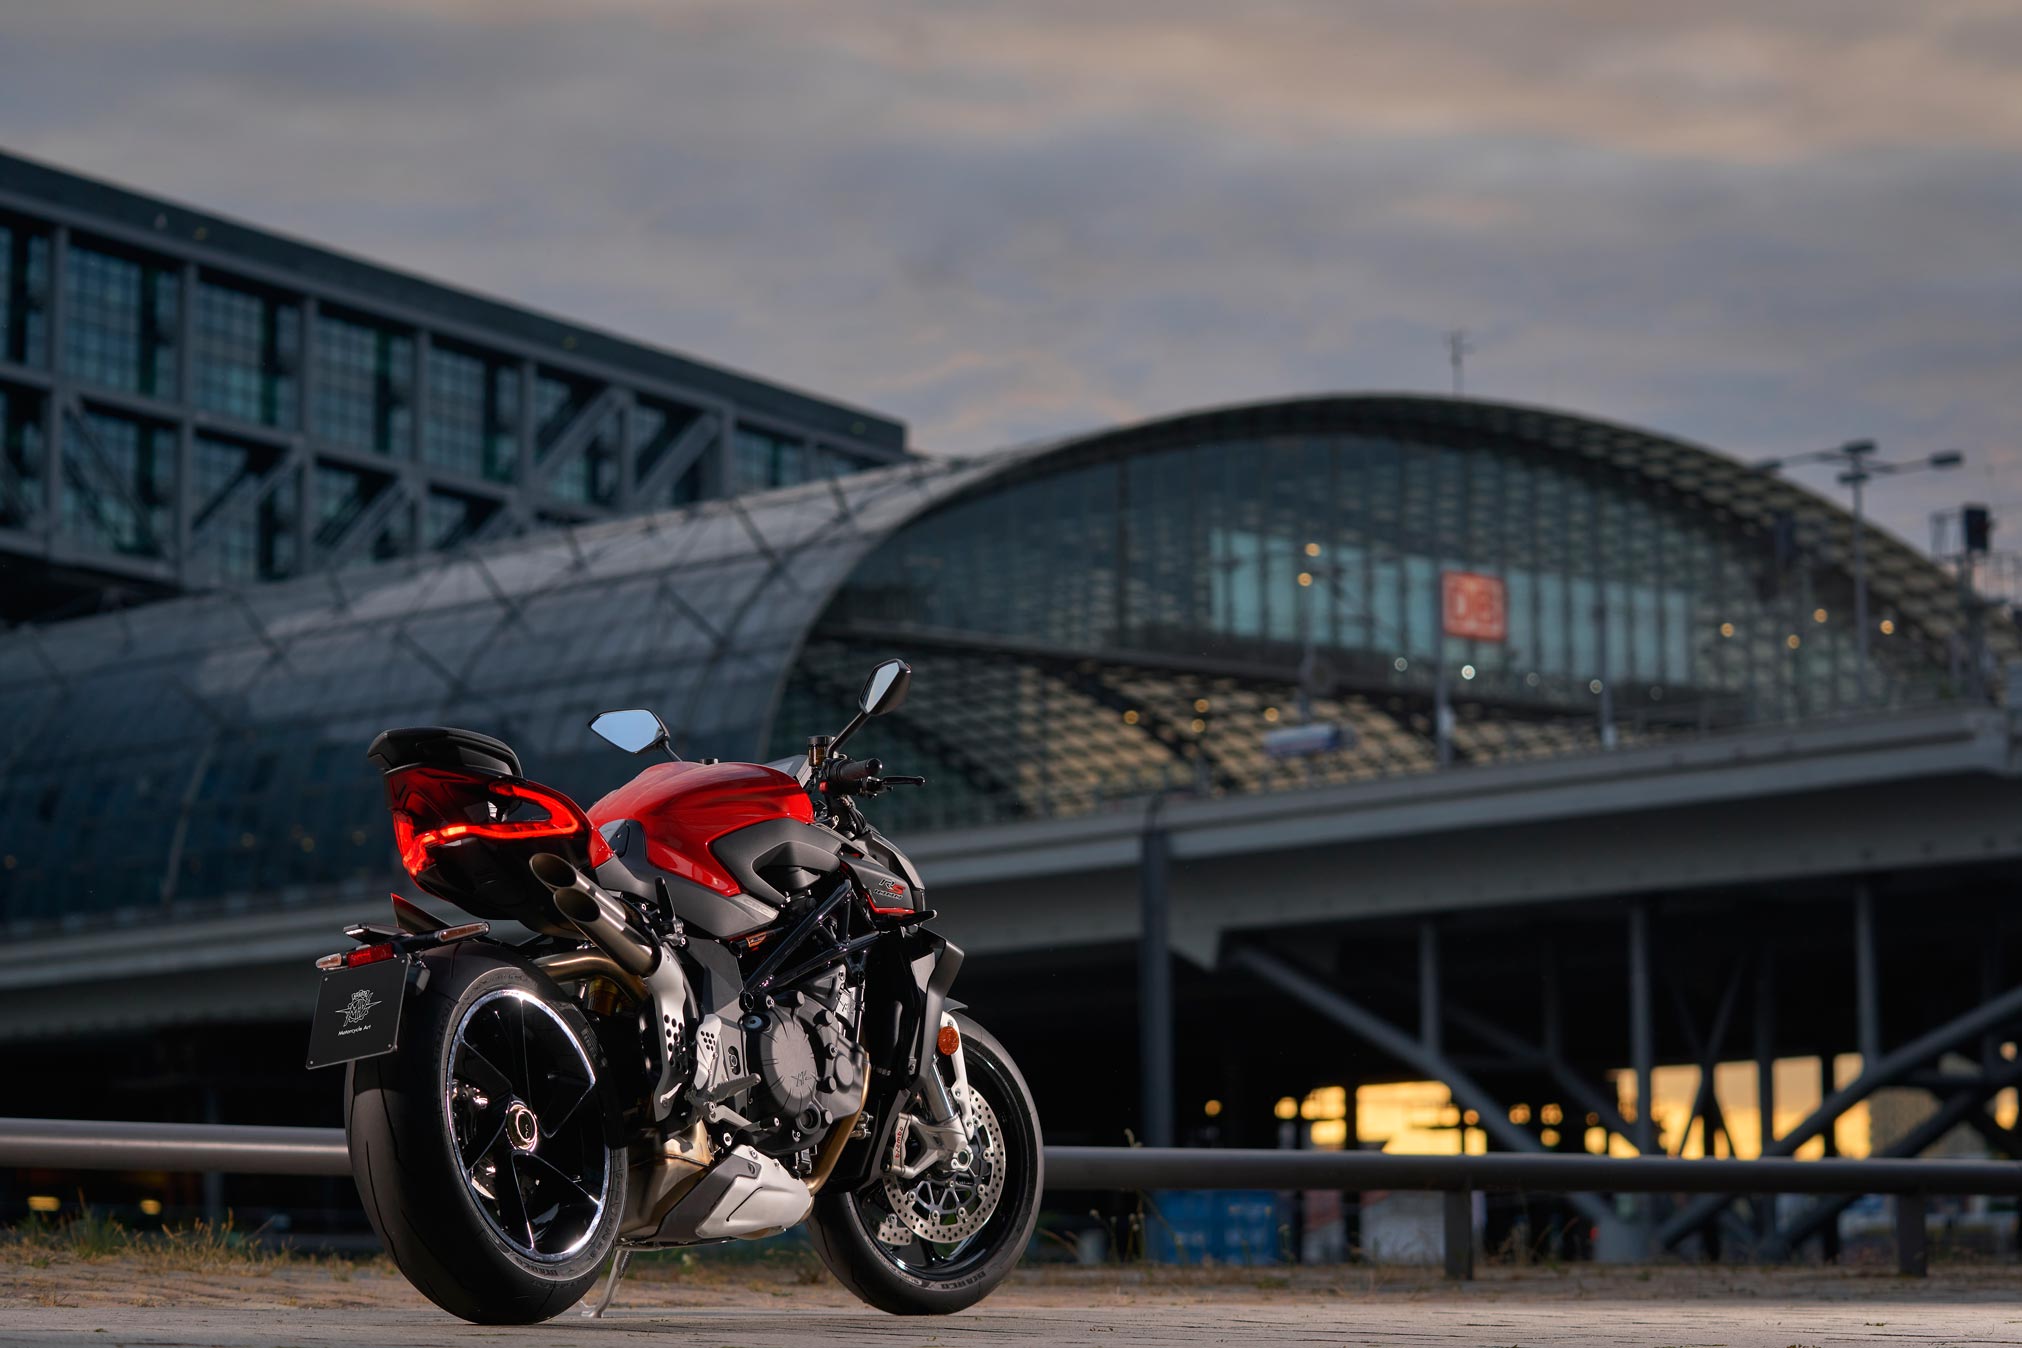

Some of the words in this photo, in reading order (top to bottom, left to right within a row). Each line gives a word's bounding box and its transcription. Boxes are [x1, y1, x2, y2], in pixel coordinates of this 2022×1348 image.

[879, 878, 905, 895] RS
[338, 1026, 362, 1036] Motorcycle
[895, 1126, 903, 1158] brembo
